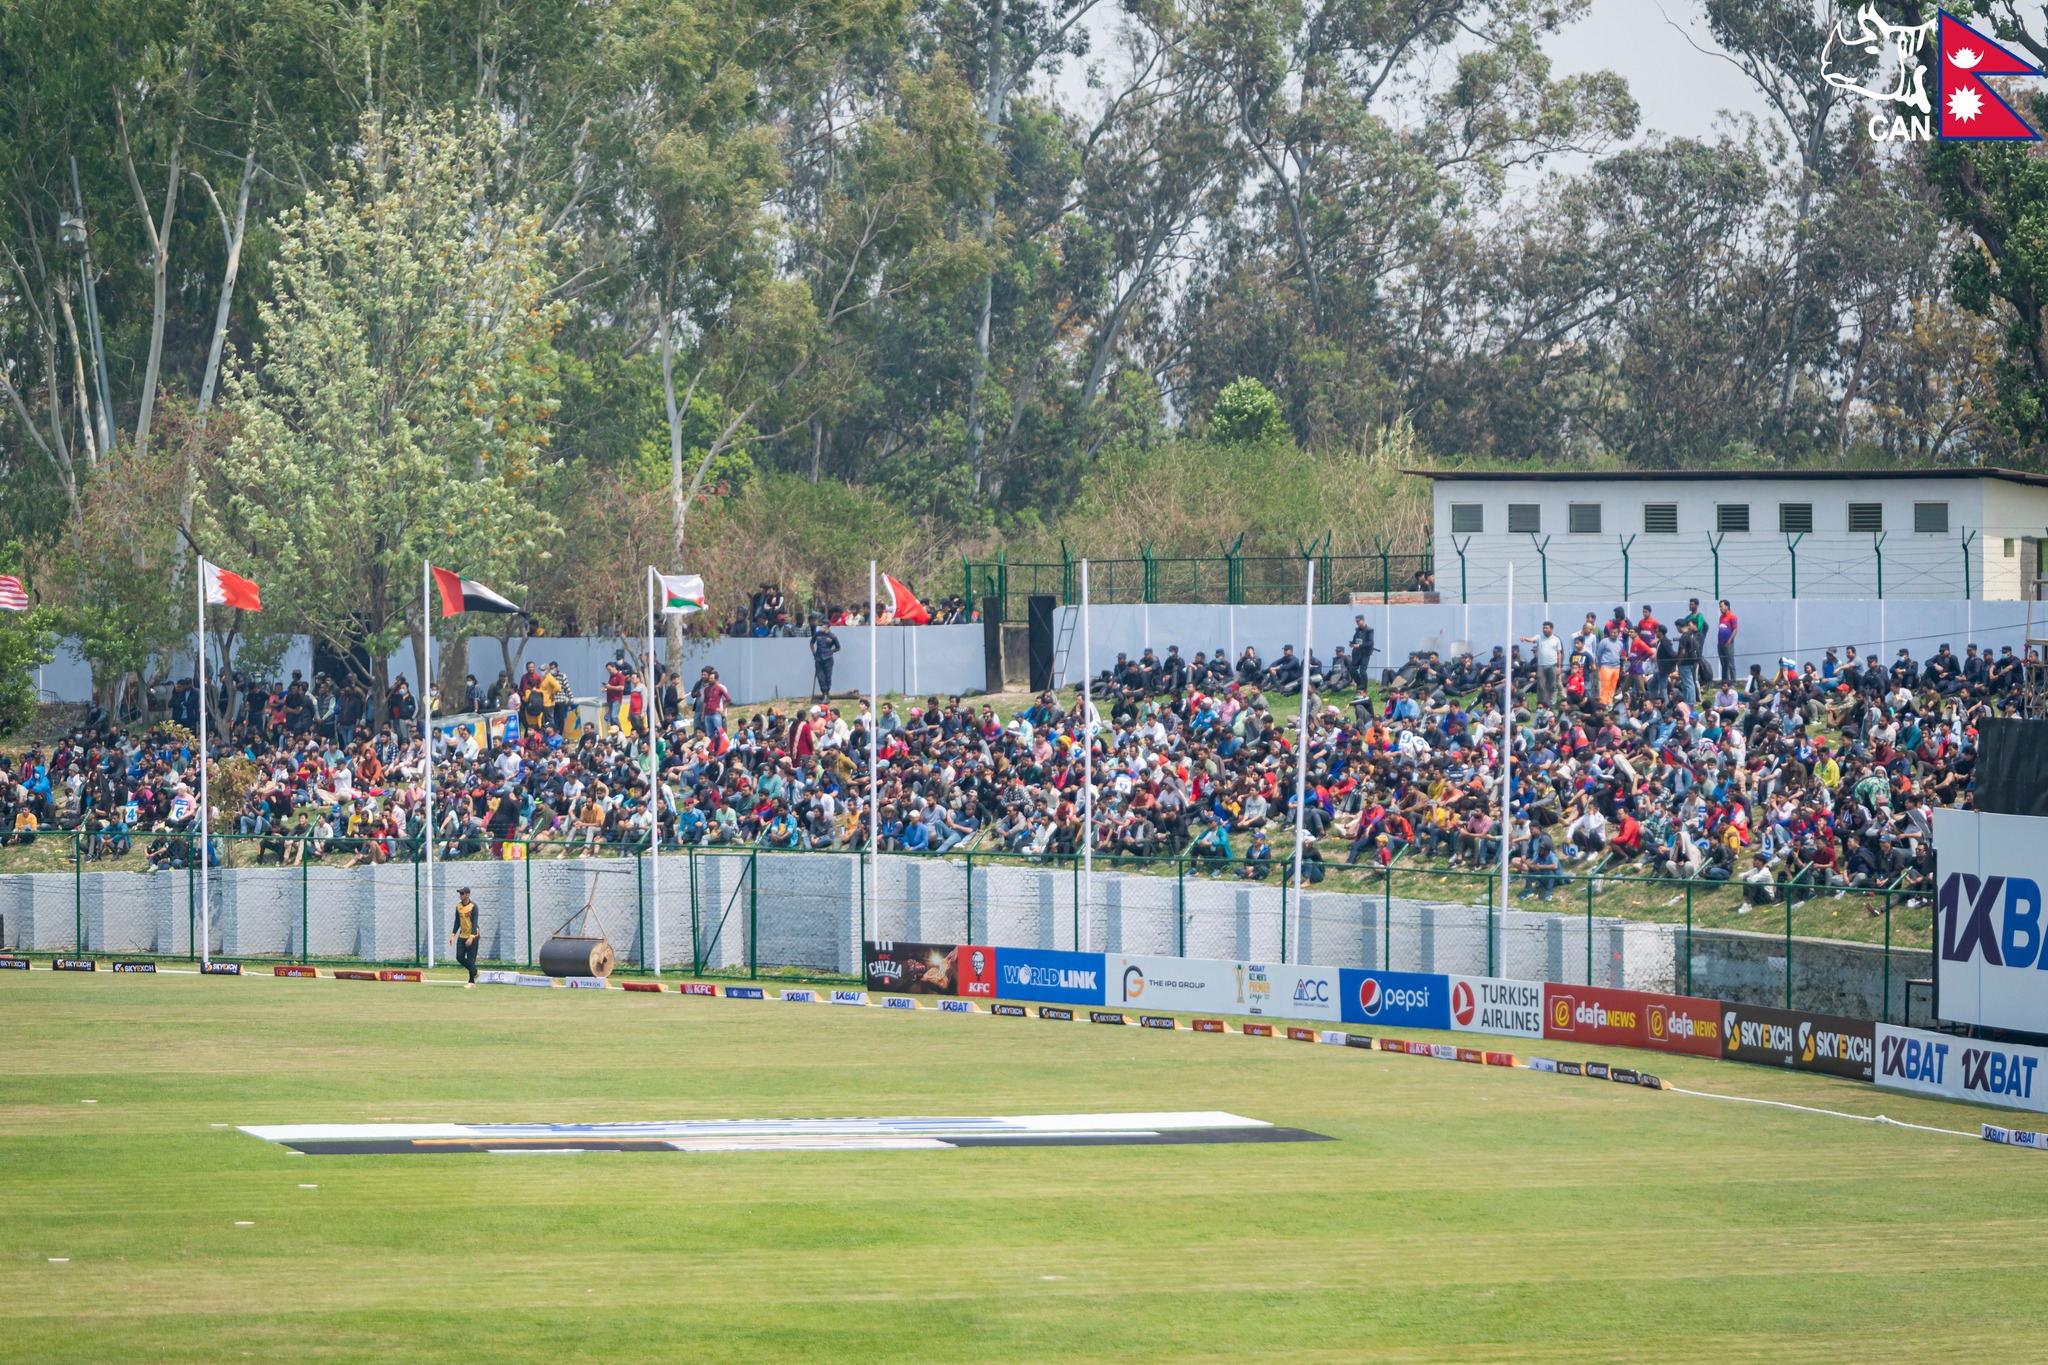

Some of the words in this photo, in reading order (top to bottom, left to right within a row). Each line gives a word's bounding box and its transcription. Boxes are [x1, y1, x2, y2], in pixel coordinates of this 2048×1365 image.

[127, 808, 136, 820] 4
[175, 807, 184, 819] 6
[1939, 872, 2048, 971] 1XB
[124, 964, 155, 973] SKYEXCH
[867, 960, 903, 977] CHIZZA
[1004, 964, 1098, 990] WORLDLINK
[693, 984, 712, 995] KFC
[968, 982, 991, 993] KFC
[1148, 979, 1164, 987] THE
[1164, 980, 1178, 988] IPG
[1178, 981, 1206, 989] GROUP
[1293, 978, 1329, 1002] ACC
[786, 992, 810, 1002] 1XBAT
[887, 998, 911, 1008] 1XBAT
[1385, 986, 1430, 1011] pepsi
[1481, 983, 1539, 1008] TURKISH
[942, 1000, 969, 1012] 1XBAT
[1481, 1010, 1540, 1032] AIRLINES
[1741, 1020, 1793, 1052] SKYEXCH
[1415, 1043, 1429, 1054] KFC
[1816, 1031, 1872, 1063] SKYEXCH
[1881, 1034, 1949, 1084] 1XBAT
[1961, 1048, 2039, 1099] 1XBAT
[1985, 1126, 2005, 1143] 1XBAT
[2014, 1130, 2036, 1144] 1XBAT
